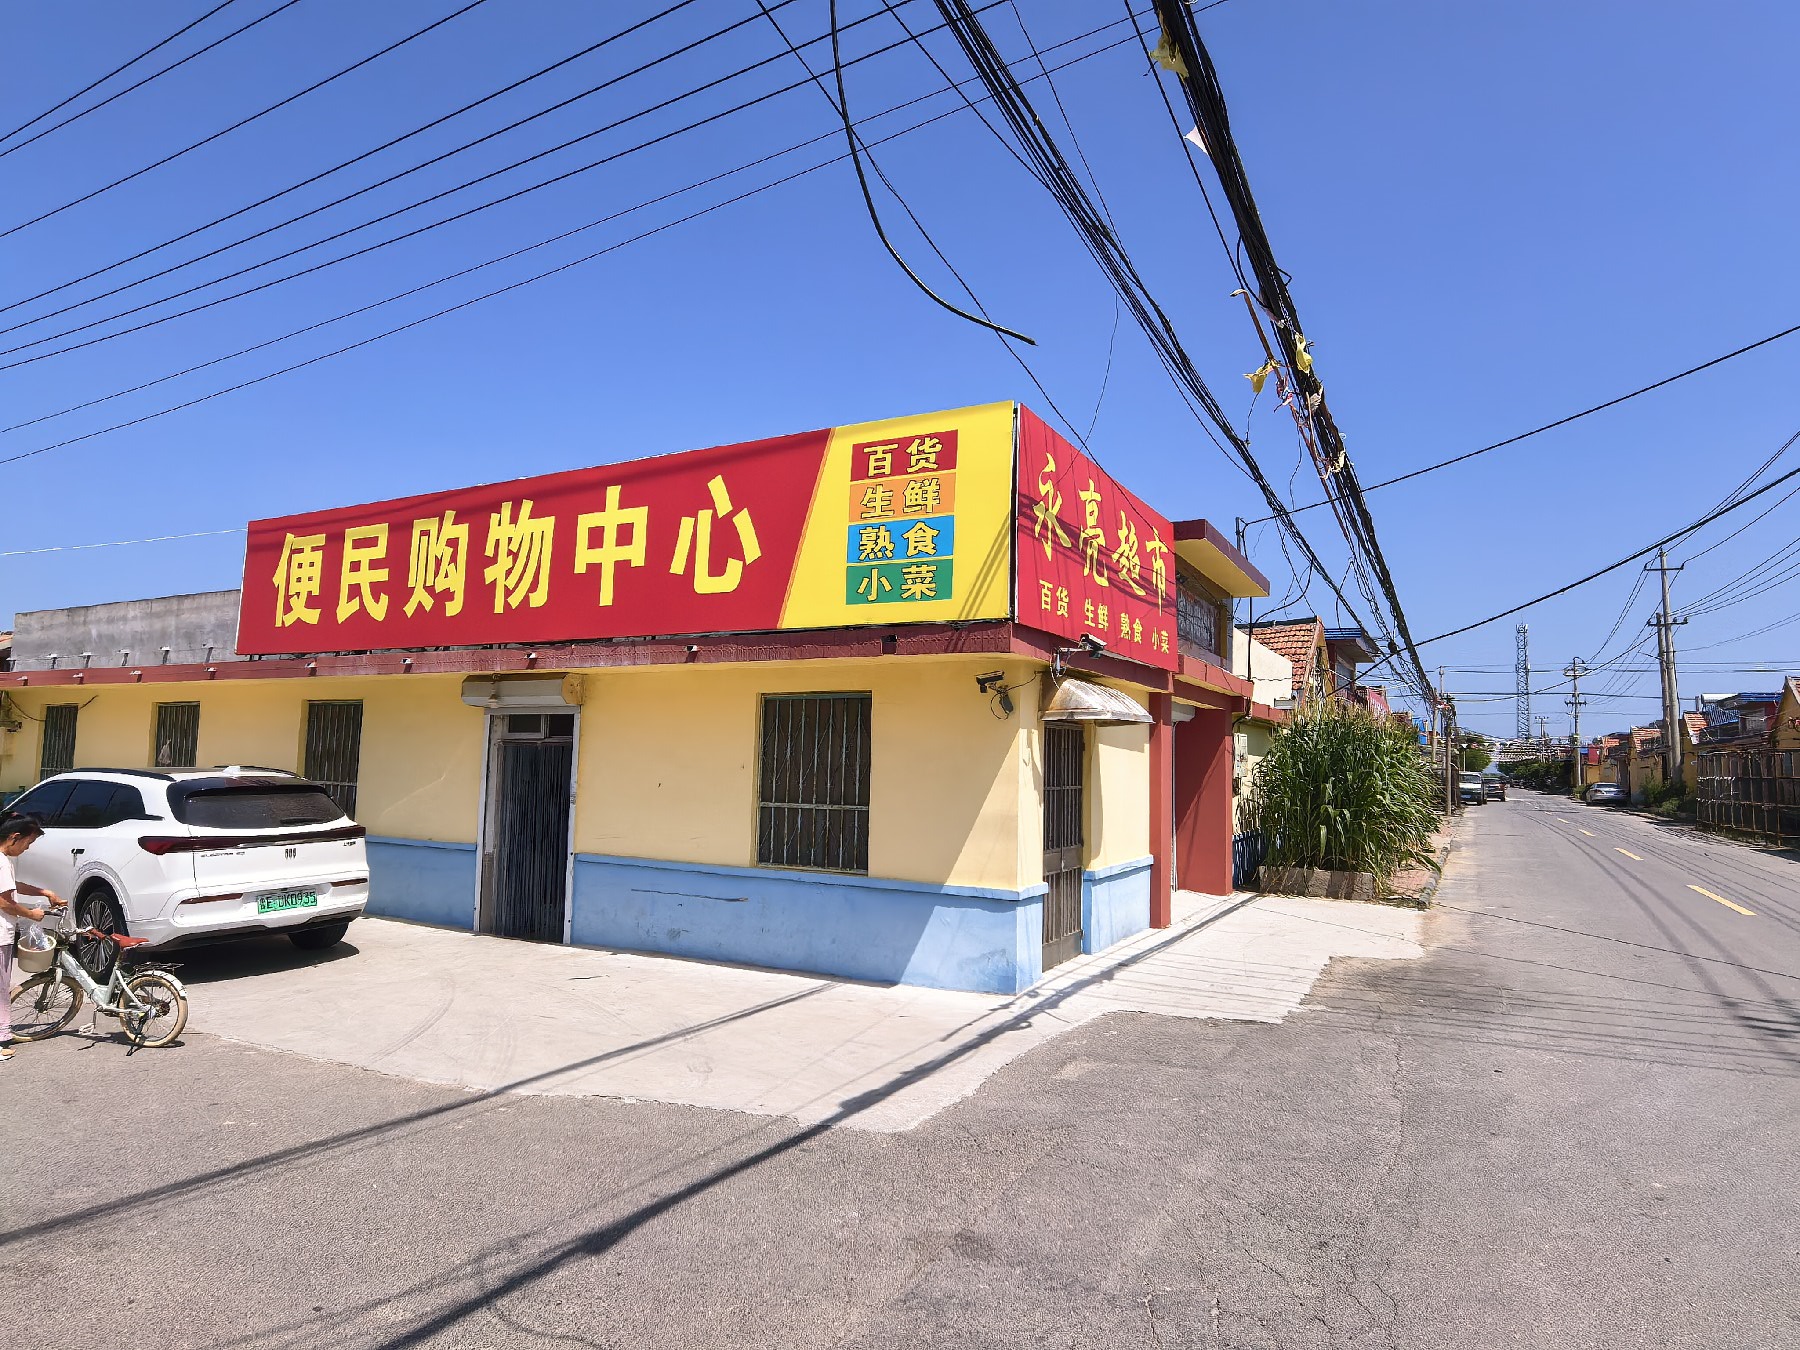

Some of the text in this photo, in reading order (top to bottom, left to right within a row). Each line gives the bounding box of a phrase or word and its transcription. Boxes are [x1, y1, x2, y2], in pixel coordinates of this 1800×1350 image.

[863, 437, 943, 477] 百货
[860, 478, 940, 519] 生鲜
[272, 474, 762, 628] 便民购物中心
[858, 521, 940, 561] 熟食
[1032, 452, 1168, 617] 永亮超市
[857, 564, 937, 602] 小菜
[1039, 579, 1169, 654] 百货 生鲜 熟食 小菜
